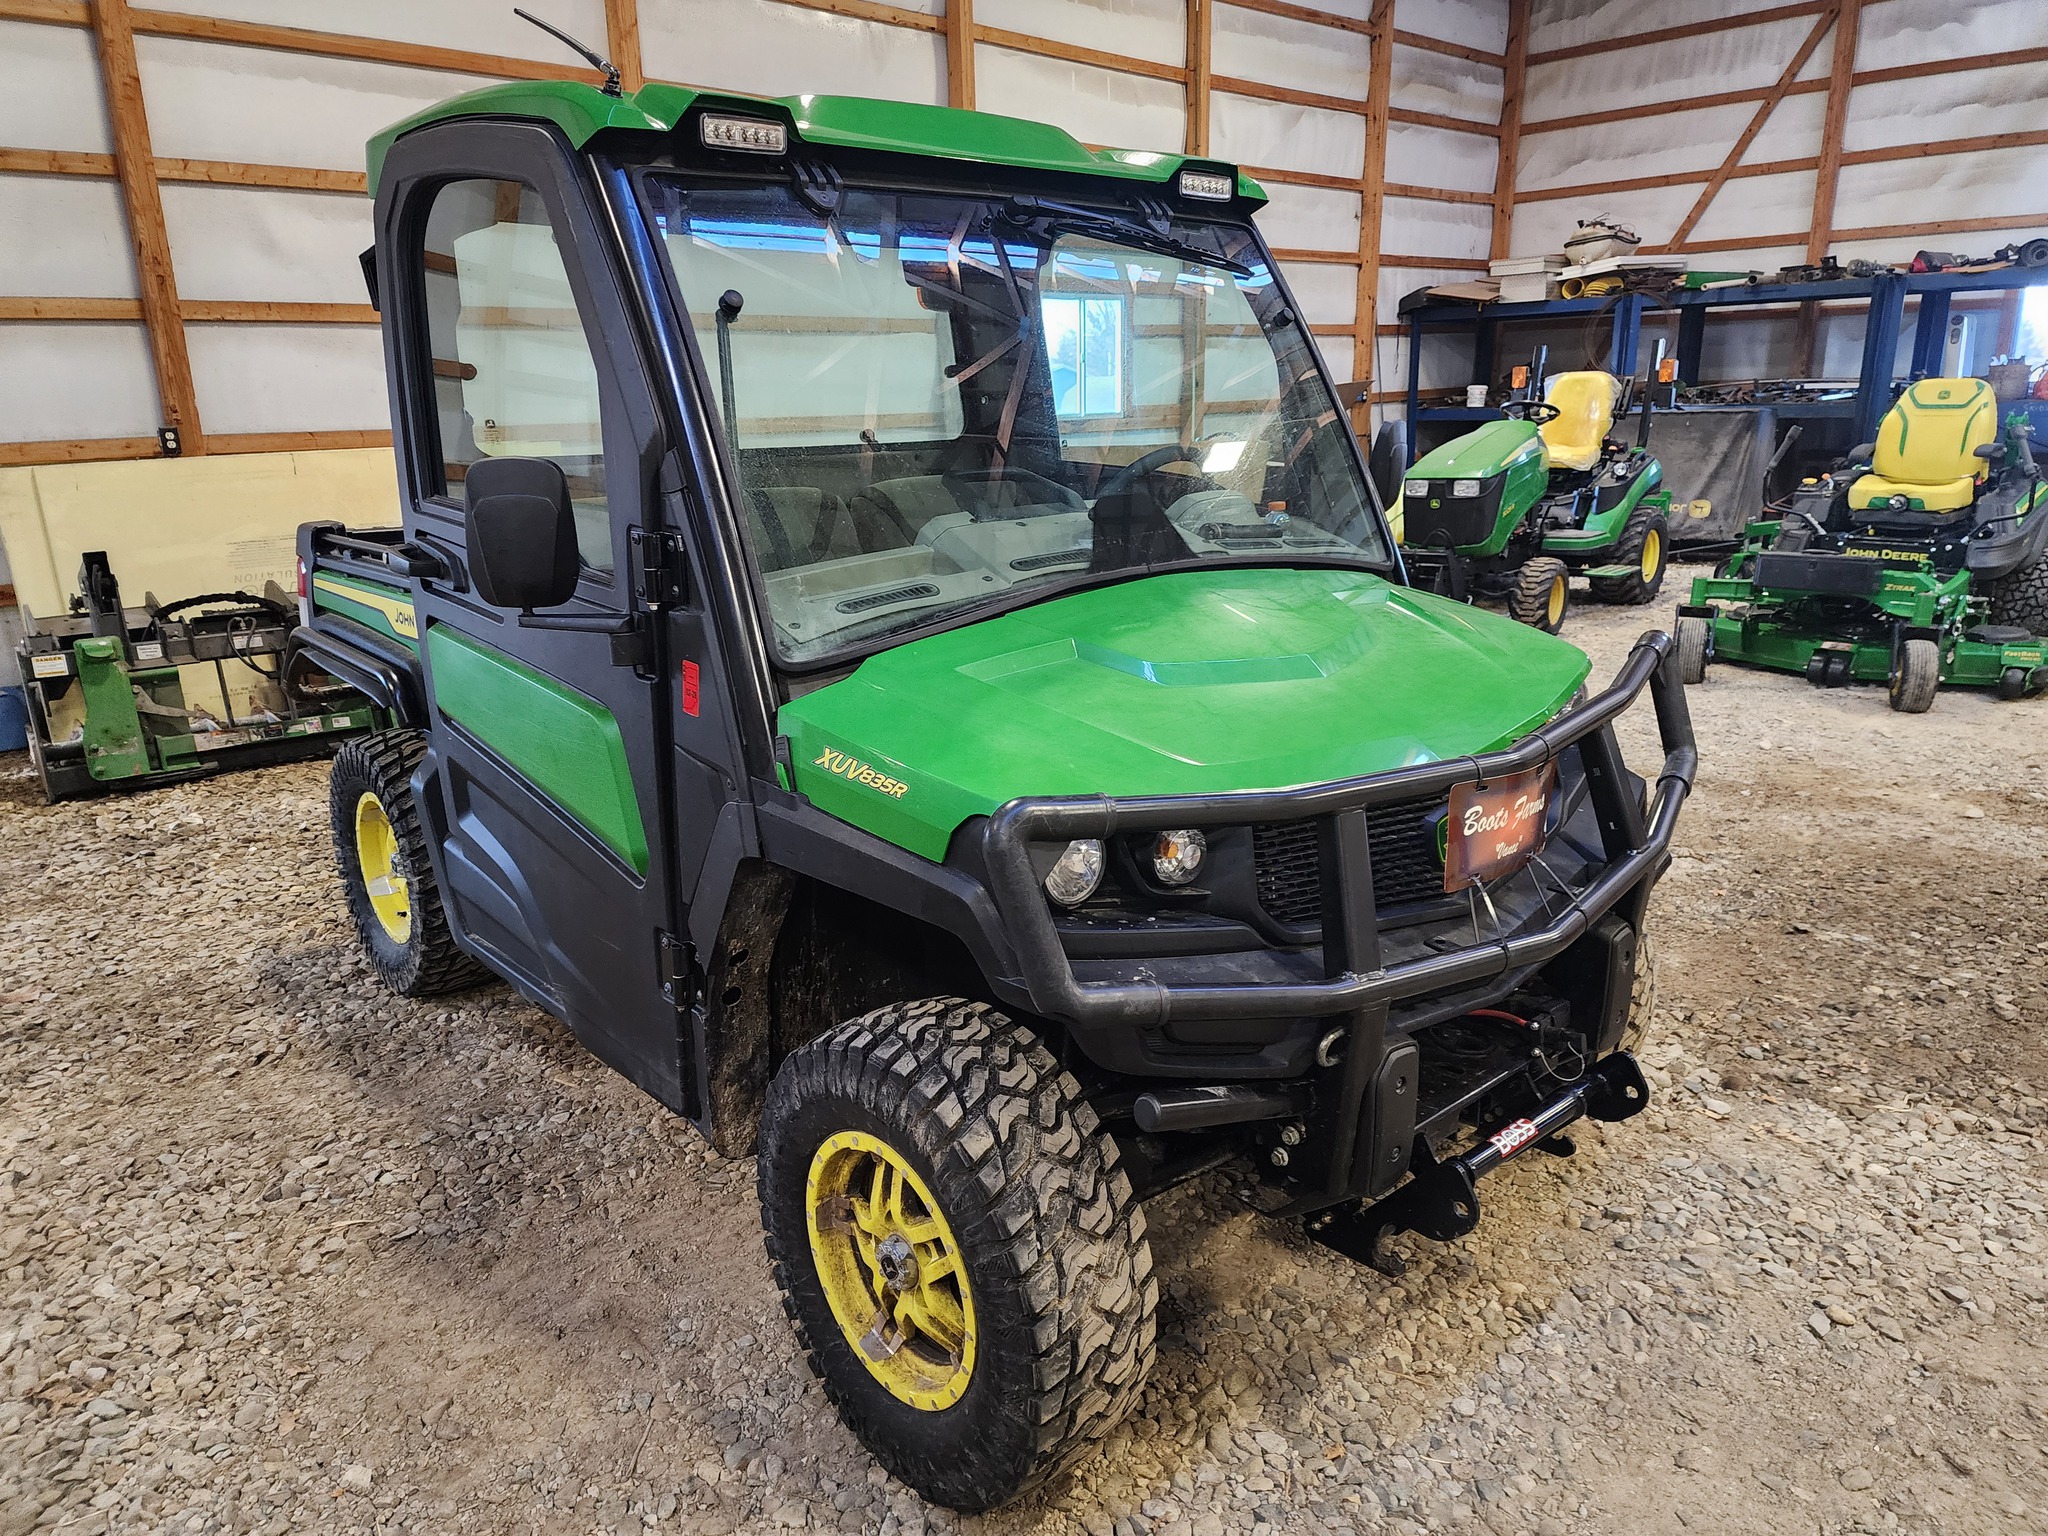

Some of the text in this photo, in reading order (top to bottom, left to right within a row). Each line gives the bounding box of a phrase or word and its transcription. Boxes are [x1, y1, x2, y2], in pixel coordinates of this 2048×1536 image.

[1842, 547, 1930, 562] JOHN DEERE
[394, 607, 416, 628] JOHN
[35, 655, 63, 663] DANGER
[812, 745, 908, 800] XUV835R
[1463, 793, 1546, 837] Boots Farms
[1489, 1117, 1537, 1155] BOSS
